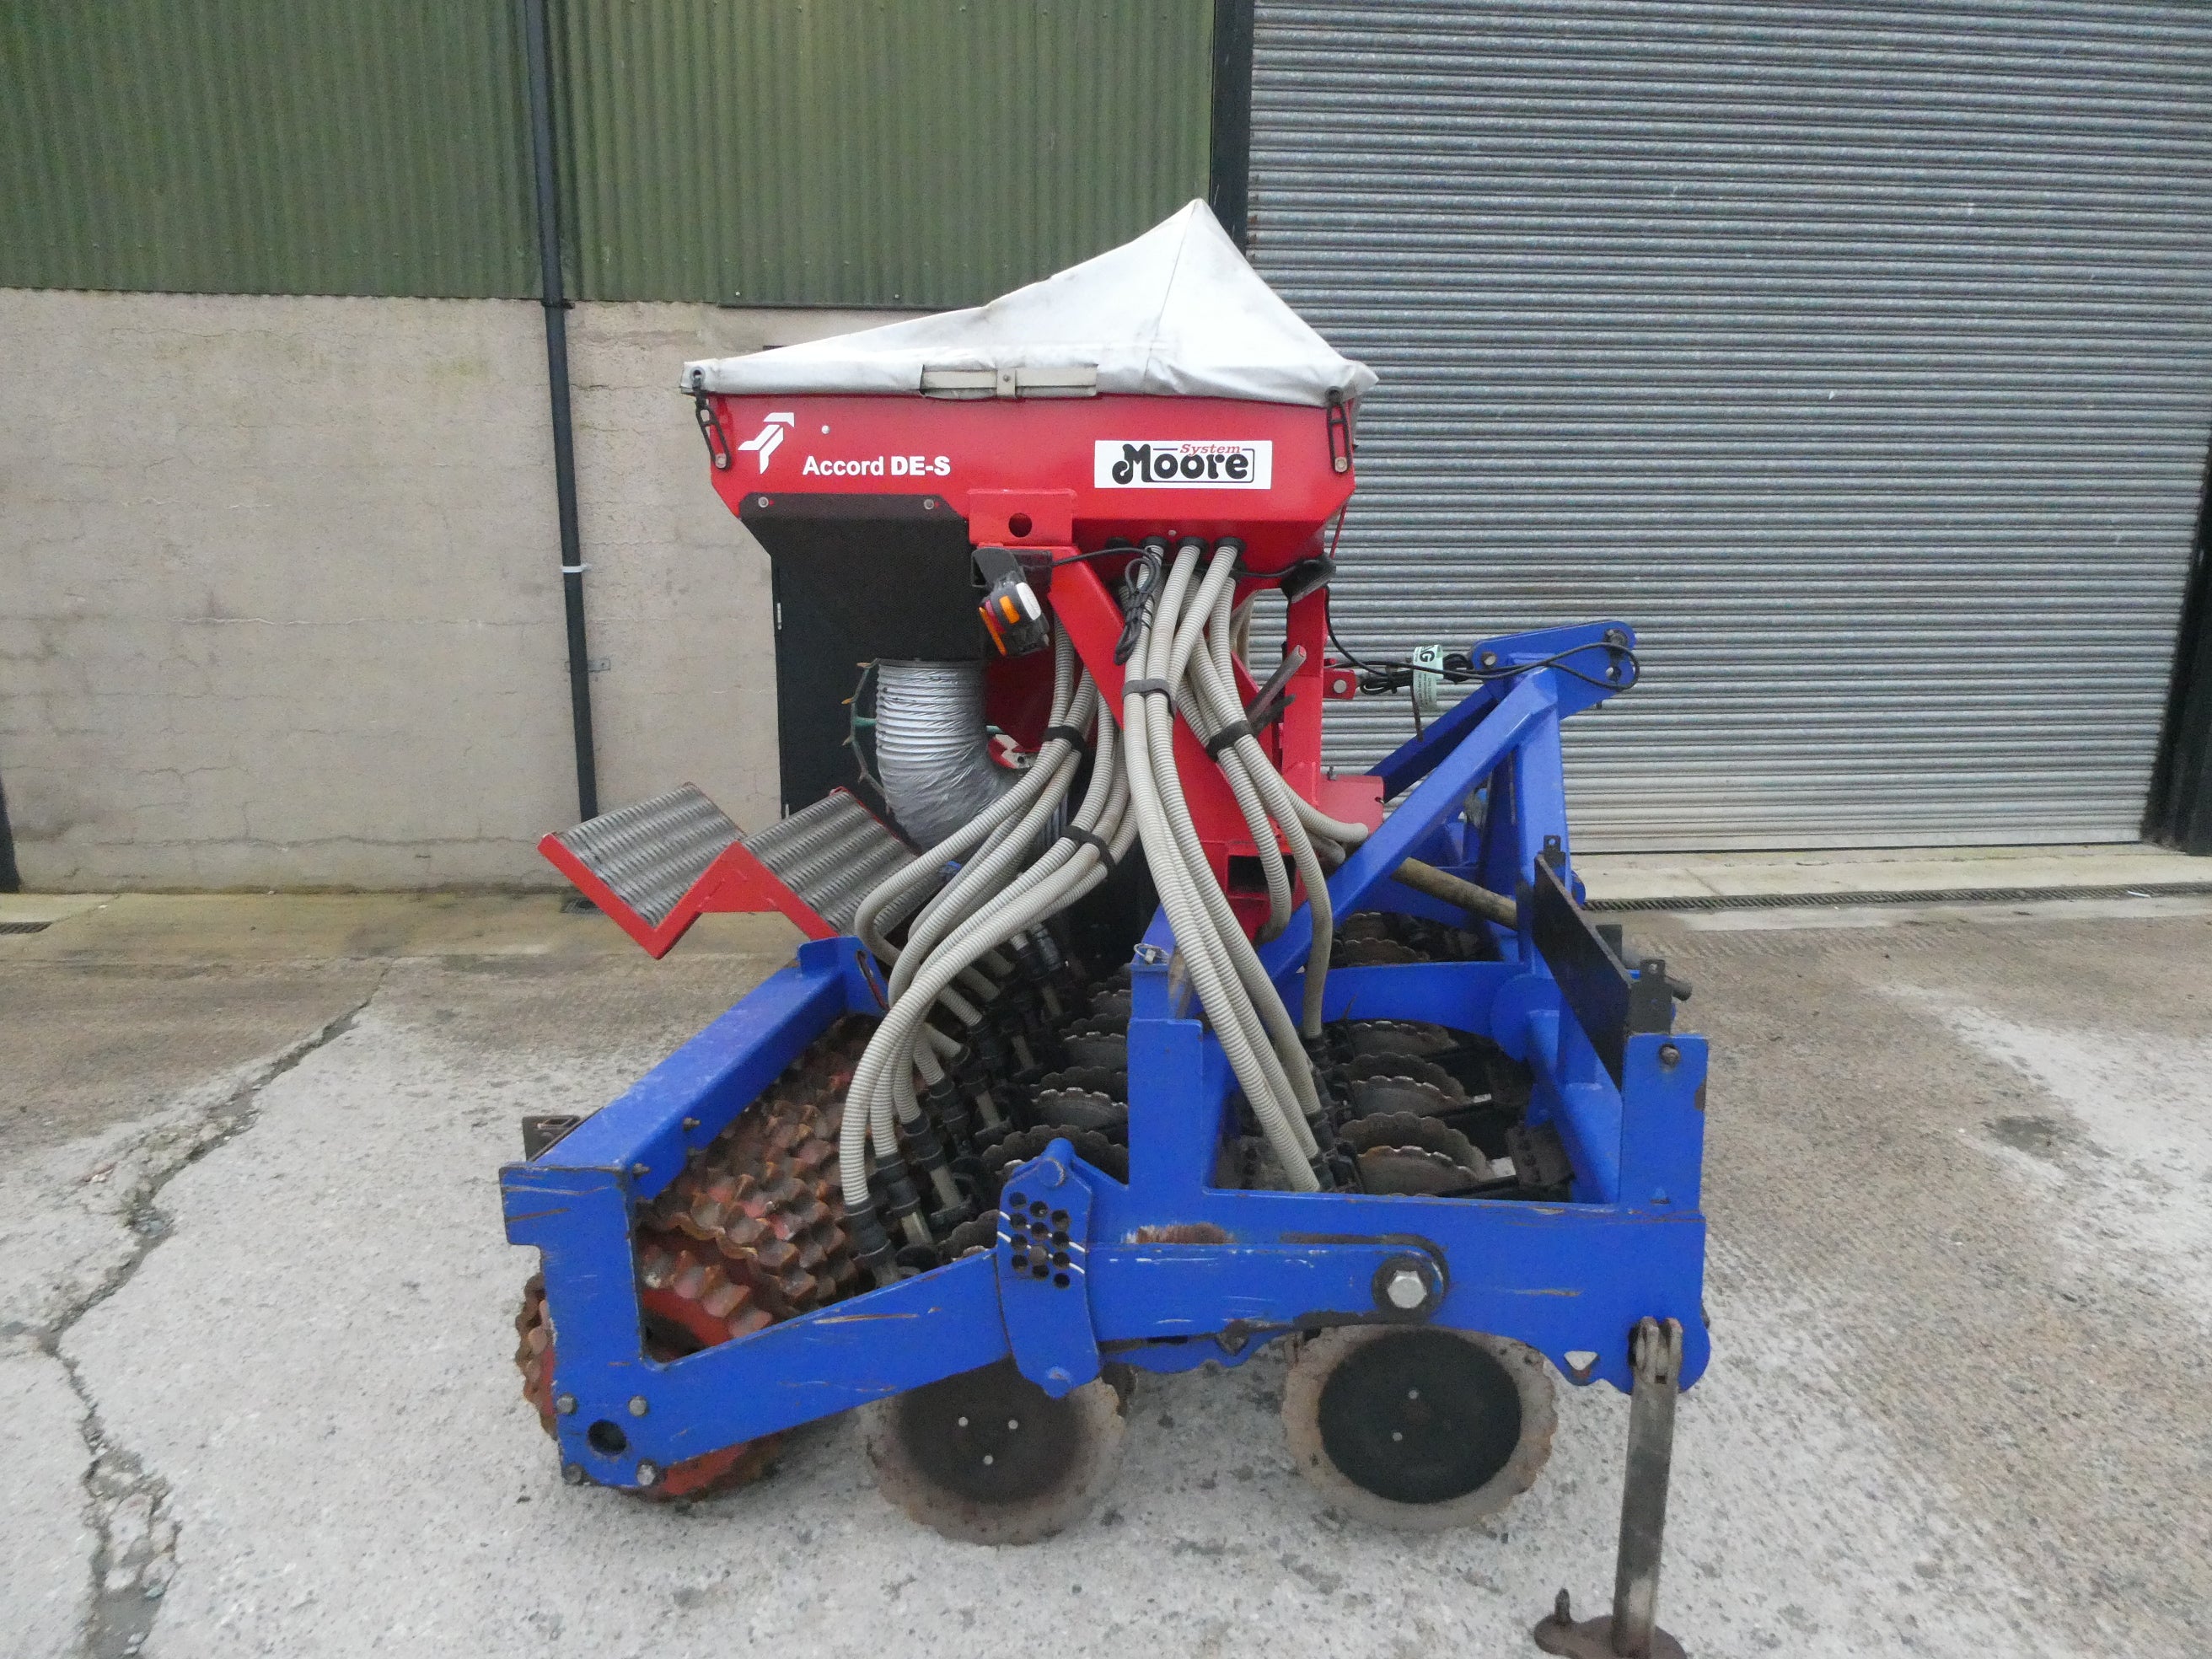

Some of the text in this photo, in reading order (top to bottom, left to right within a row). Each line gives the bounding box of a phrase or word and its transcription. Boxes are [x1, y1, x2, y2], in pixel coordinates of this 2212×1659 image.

[1180, 443, 1241, 456] System
[803, 455, 951, 475] Accord DE-S
[1112, 443, 1248, 485] Moore
